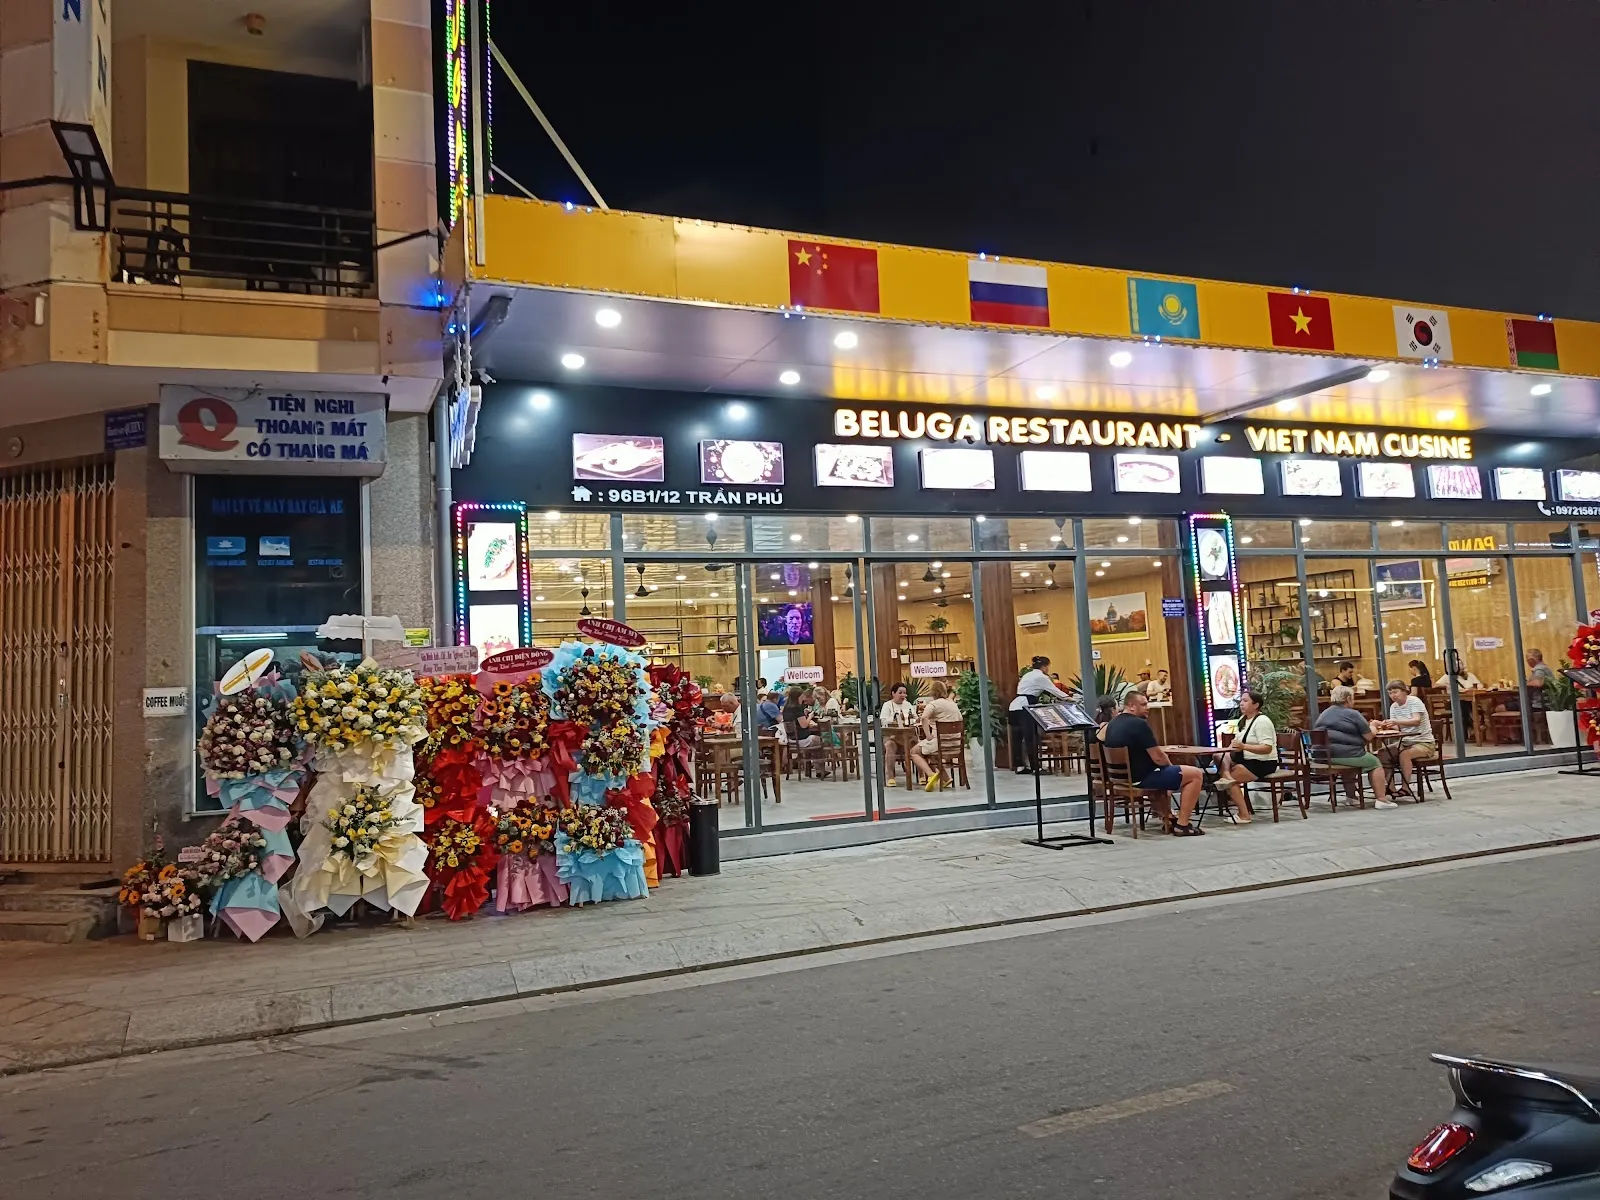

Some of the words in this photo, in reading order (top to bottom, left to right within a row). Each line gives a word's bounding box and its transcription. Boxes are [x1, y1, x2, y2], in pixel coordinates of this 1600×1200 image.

[267, 393, 305, 415] TIỆN
[315, 399, 355, 415] NGHI
[330, 418, 367, 436] MÁT
[834, 408, 981, 441] BELUGA
[987, 416, 1200, 449] RESTAURANT
[1245, 426, 1308, 453] VIET
[1312, 429, 1379, 456] NAM
[1380, 432, 1472, 460] CUSINE
[246, 438, 271, 457] CÓ
[276, 443, 336, 459] THANG
[608, 489, 681, 504] 96B1/12
[685, 487, 741, 504] TRẦN
[745, 489, 784, 505] PHÚ
[786, 670, 821, 681] Wellcom
[913, 664, 944, 675] Wellcom
[145, 696, 168, 708] COFFEE
